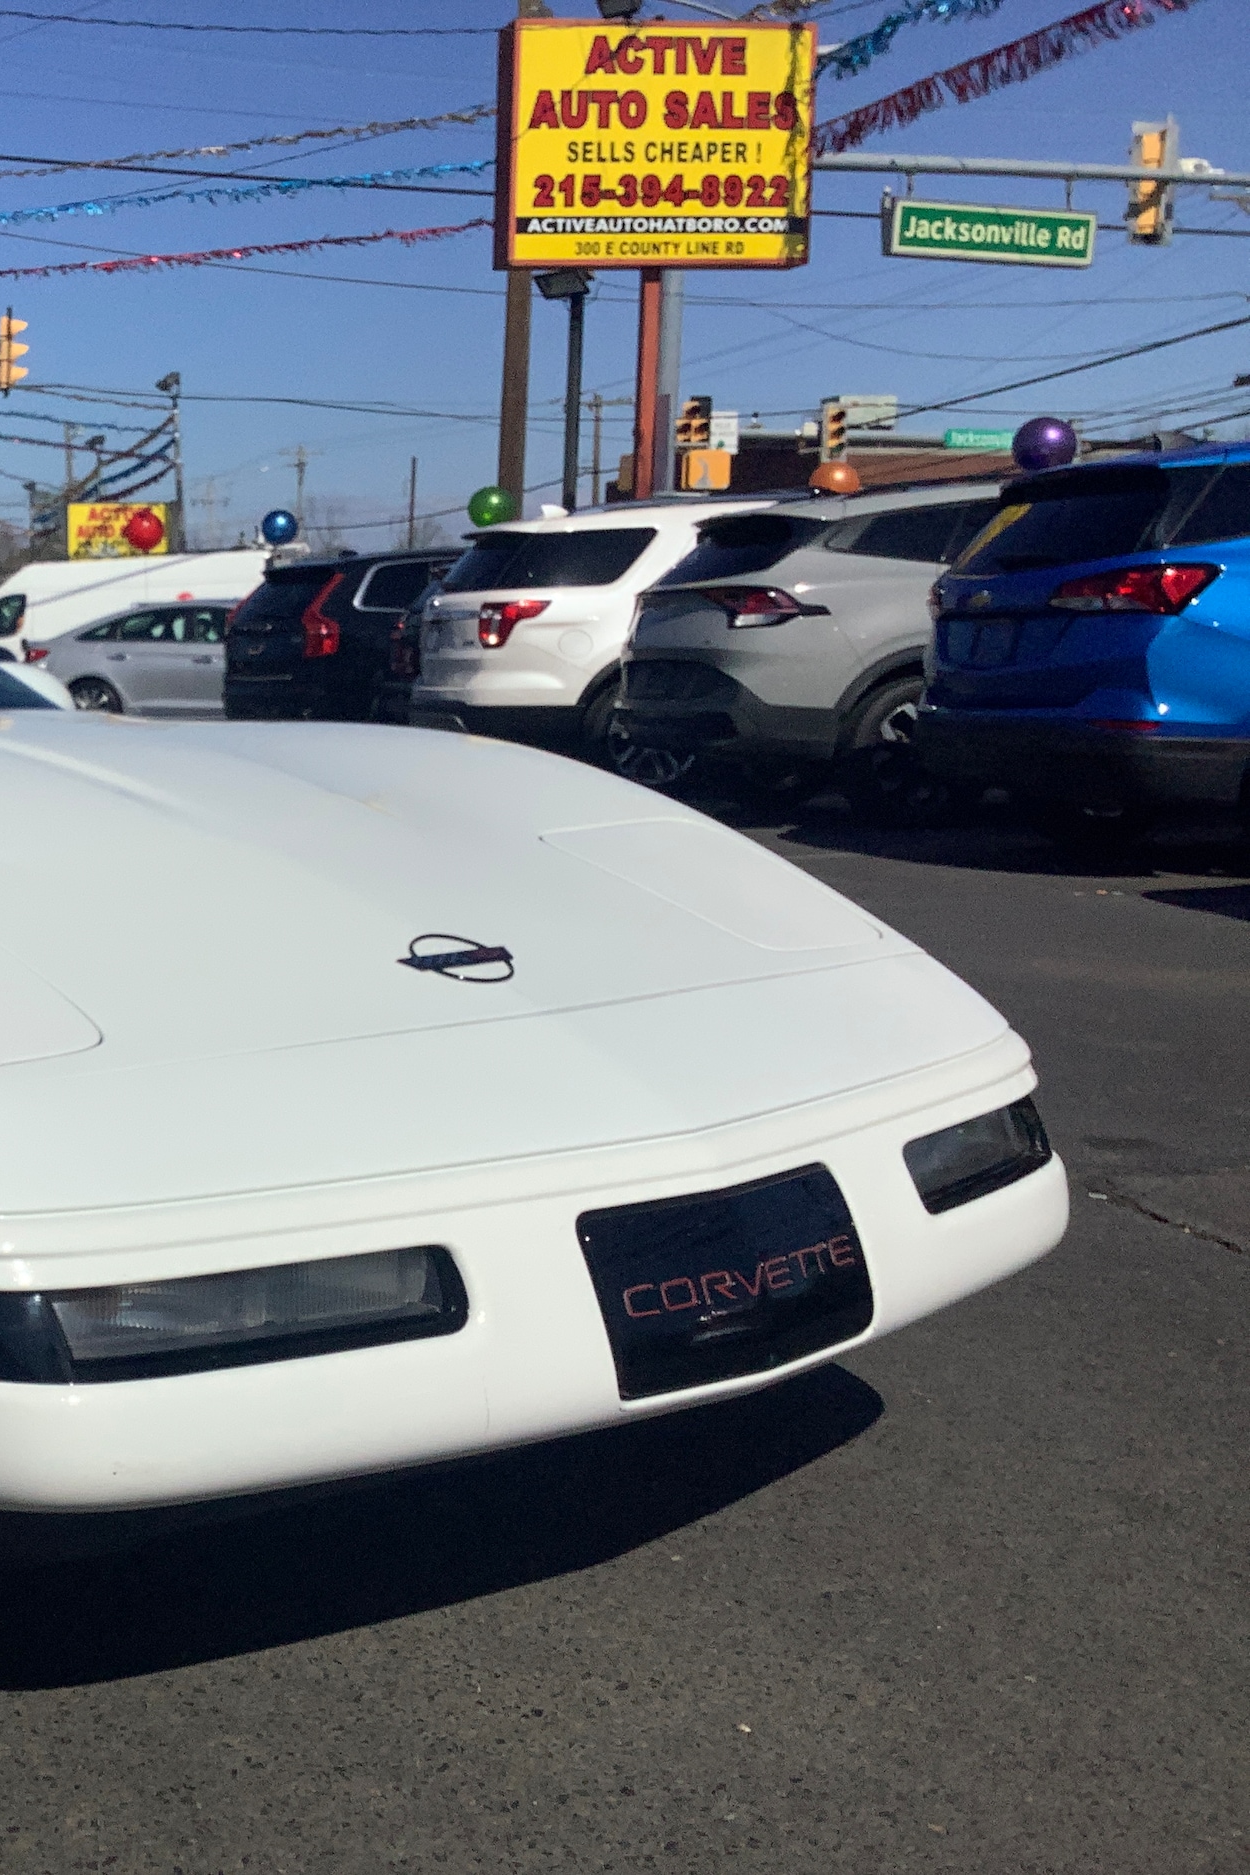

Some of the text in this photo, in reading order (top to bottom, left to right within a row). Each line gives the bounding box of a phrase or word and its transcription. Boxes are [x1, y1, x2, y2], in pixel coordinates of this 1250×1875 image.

[584, 35, 747, 76] ACTIVE
[528, 90, 798, 131] AUTO SALES
[567, 141, 636, 164] SELLS
[644, 142, 748, 164] CHEAPER
[533, 174, 791, 208] 215-394-8922
[526, 217, 789, 234] ACTIVEAUTOHATBORO.COM
[904, 216, 1087, 250] Jacksonville Rd
[575, 241, 745, 256] 300 E COUNTY LINE RD
[623, 1234, 855, 1318] CORVETTE
